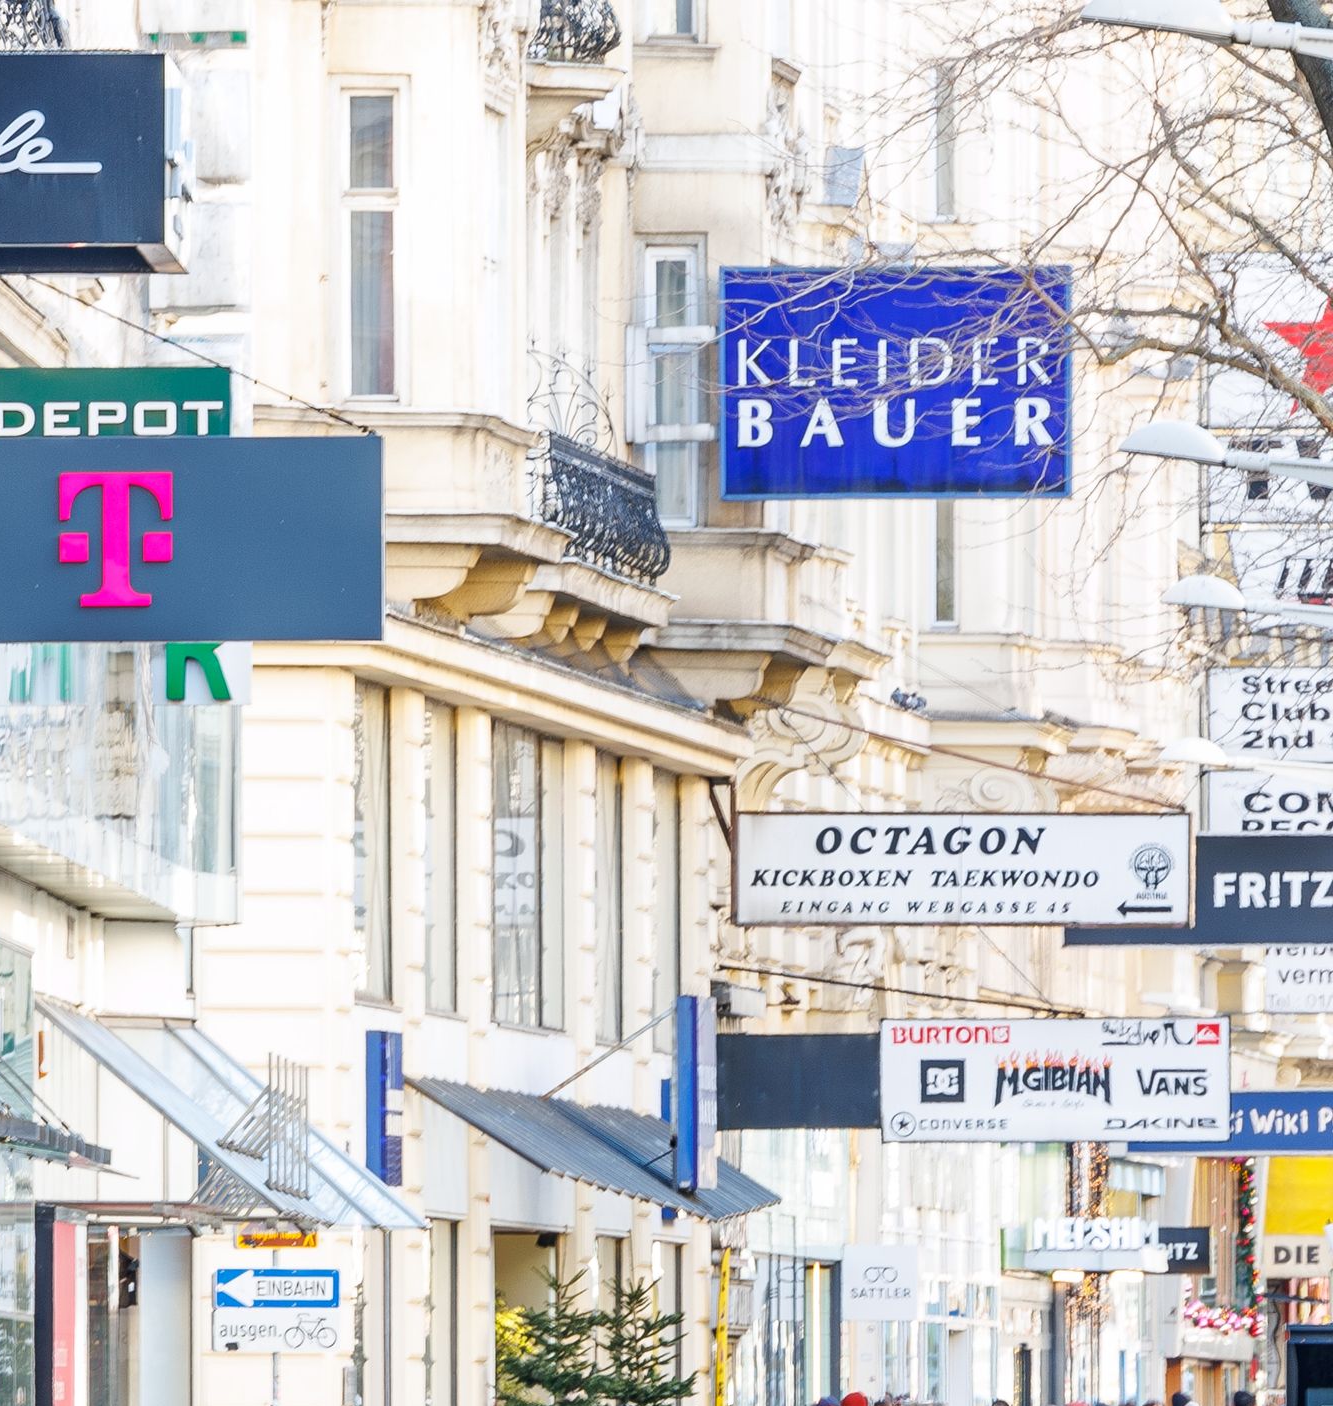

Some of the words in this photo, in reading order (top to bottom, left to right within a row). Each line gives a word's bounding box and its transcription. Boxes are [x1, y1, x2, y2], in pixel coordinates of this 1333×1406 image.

[737, 336, 1053, 388] KLEIDER
[737, 396, 1054, 449] BAUER
[1241, 676, 1333, 696] Stree
[814, 826, 1047, 856] OCTAGON
[750, 869, 913, 888] KICKBOXEN
[931, 870, 1101, 888] TAEKWONDO
[780, 901, 891, 914] EINGANG
[907, 901, 1037, 915] WEBGASSE
[891, 1025, 992, 1044] BURTON
[1136, 1068, 1208, 1097] VANS
[1274, 1246, 1320, 1265] DIE
[256, 1280, 327, 1297] EINBAHN
[851, 1287, 912, 1299] SATTLER
[219, 1323, 283, 1341] ausgen.
